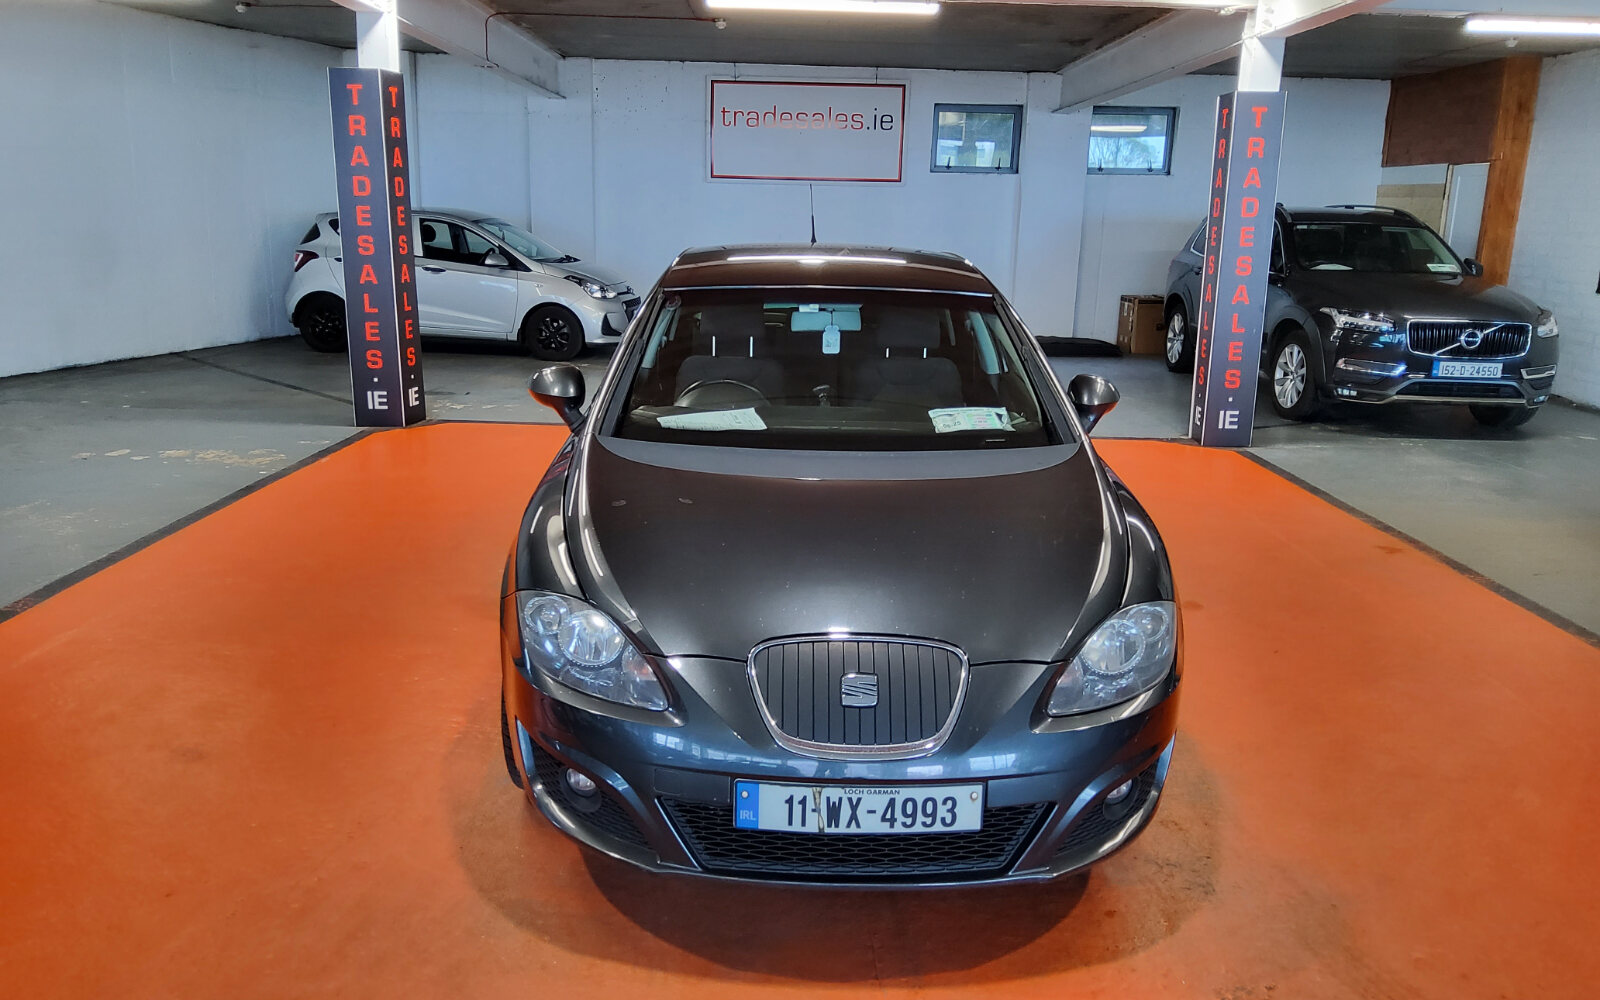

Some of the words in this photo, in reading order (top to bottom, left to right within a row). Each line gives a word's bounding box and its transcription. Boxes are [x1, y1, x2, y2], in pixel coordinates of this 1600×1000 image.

[720, 104, 895, 131] tradesales.ie
[1441, 364, 1499, 377] 152-D-24550
[843, 788, 865, 796] LOCH
[739, 808, 757, 821] IRL
[784, 794, 958, 830] 11-WX-4993
